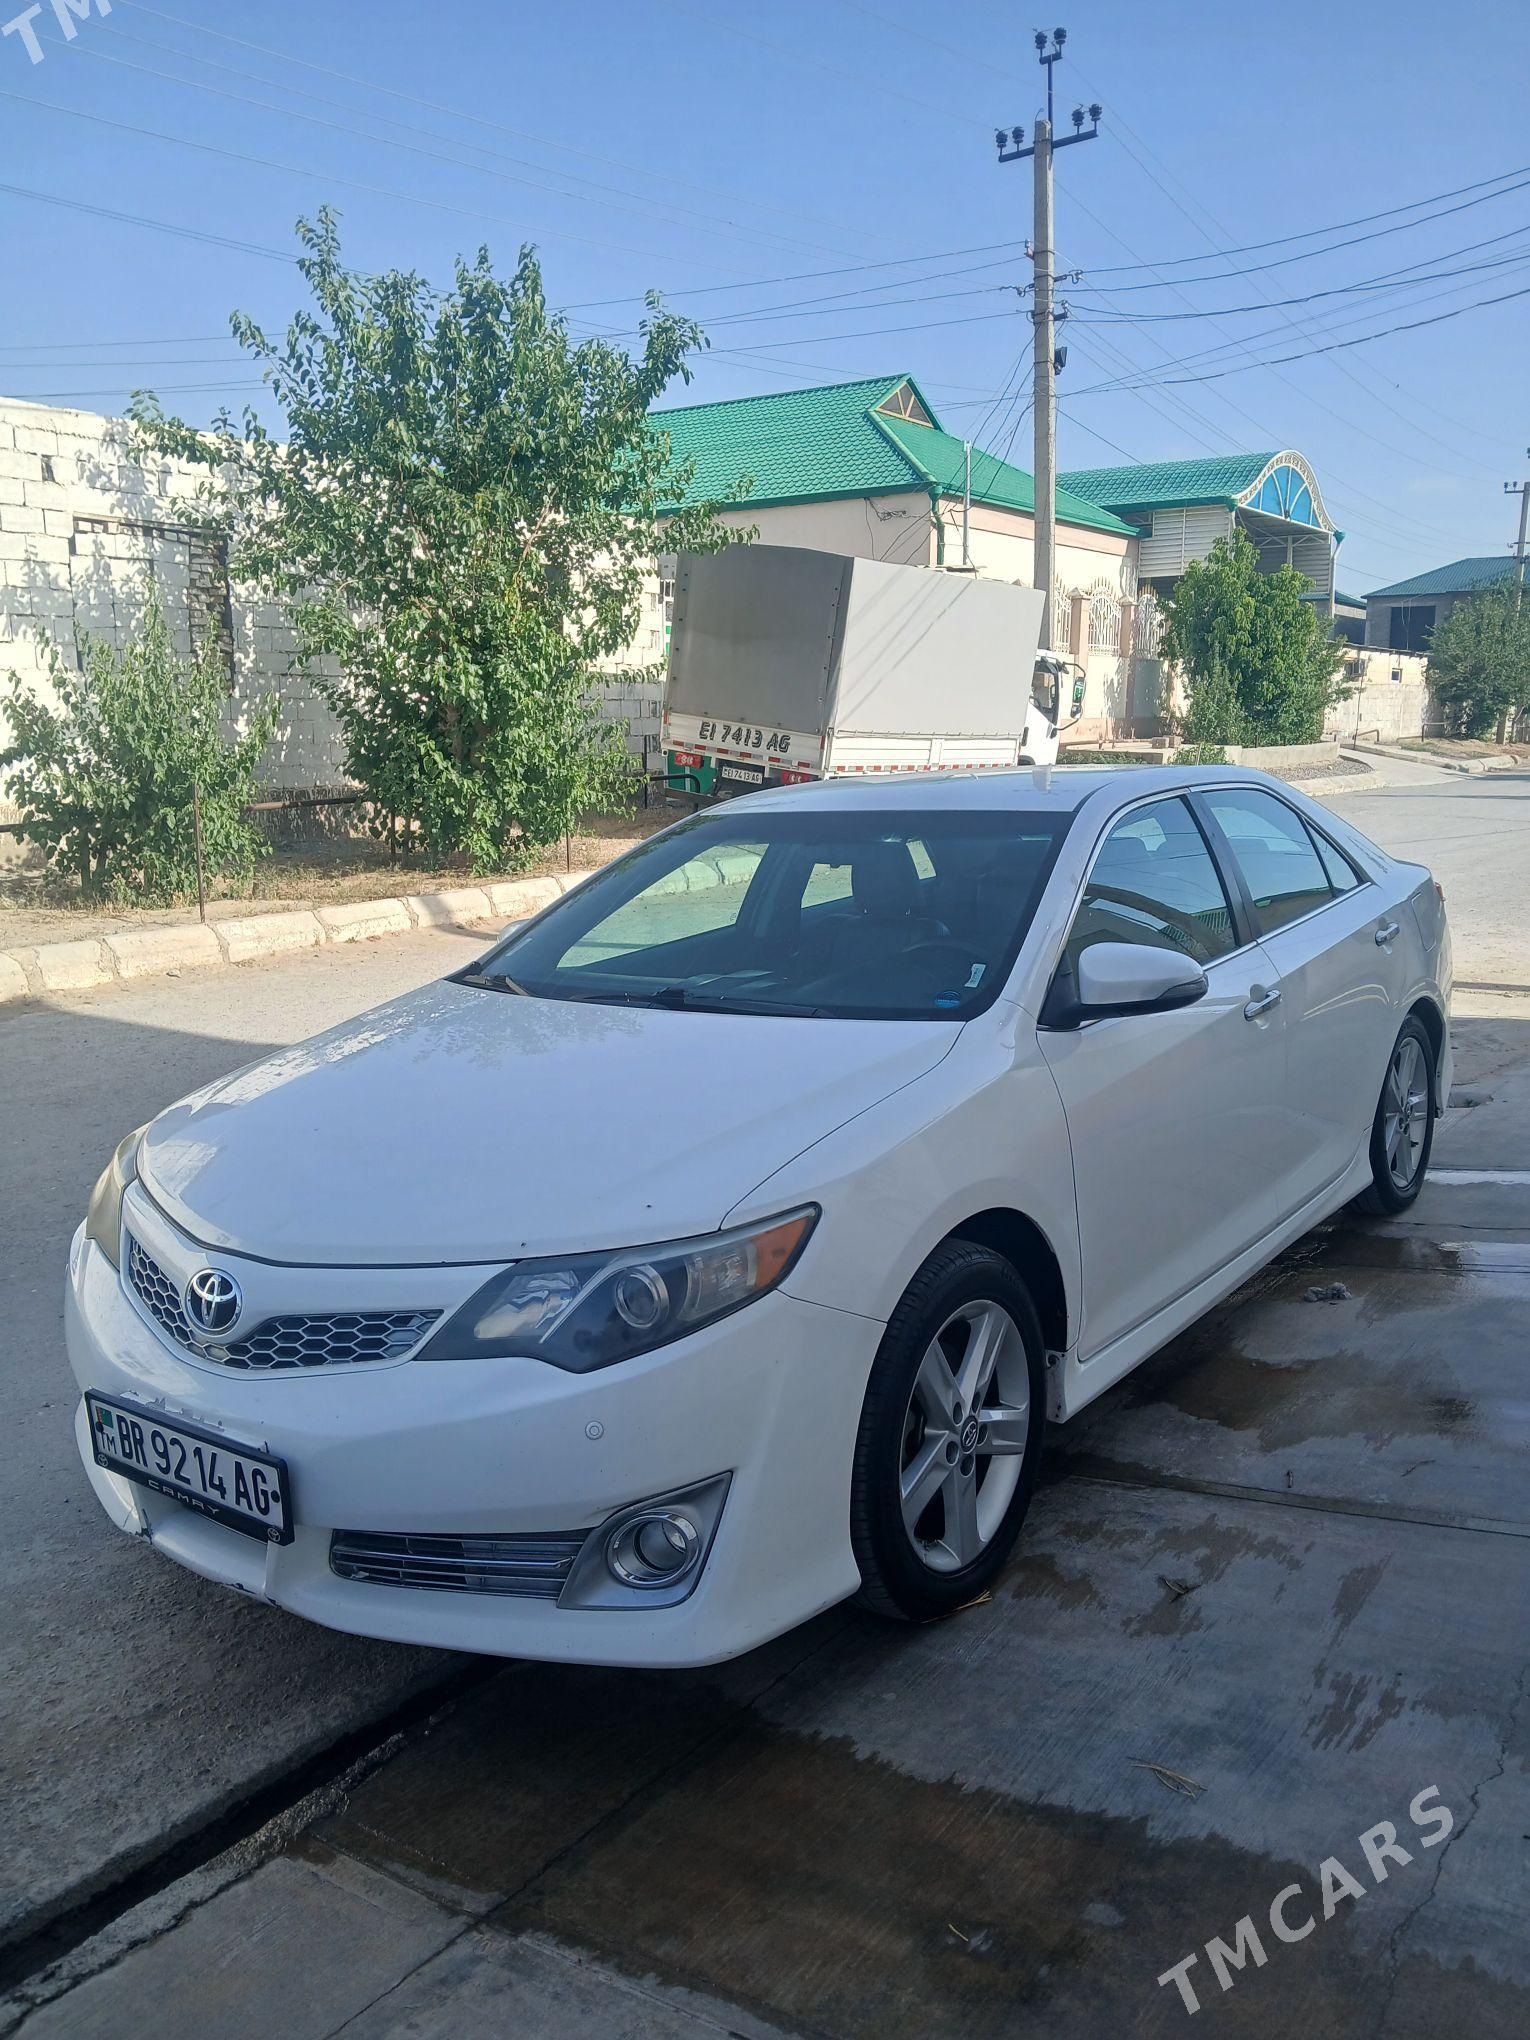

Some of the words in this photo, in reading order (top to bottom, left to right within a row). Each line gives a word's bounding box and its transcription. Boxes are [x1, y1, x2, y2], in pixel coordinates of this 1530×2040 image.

[721, 724, 763, 748] 7413
[766, 732, 791, 753] AG
[101, 1432, 117, 1454] TM
[116, 1413, 148, 1468] BR
[150, 1429, 227, 1500] 9214
[234, 1460, 270, 1516] AG
[147, 1479, 219, 1515] CAMRY
